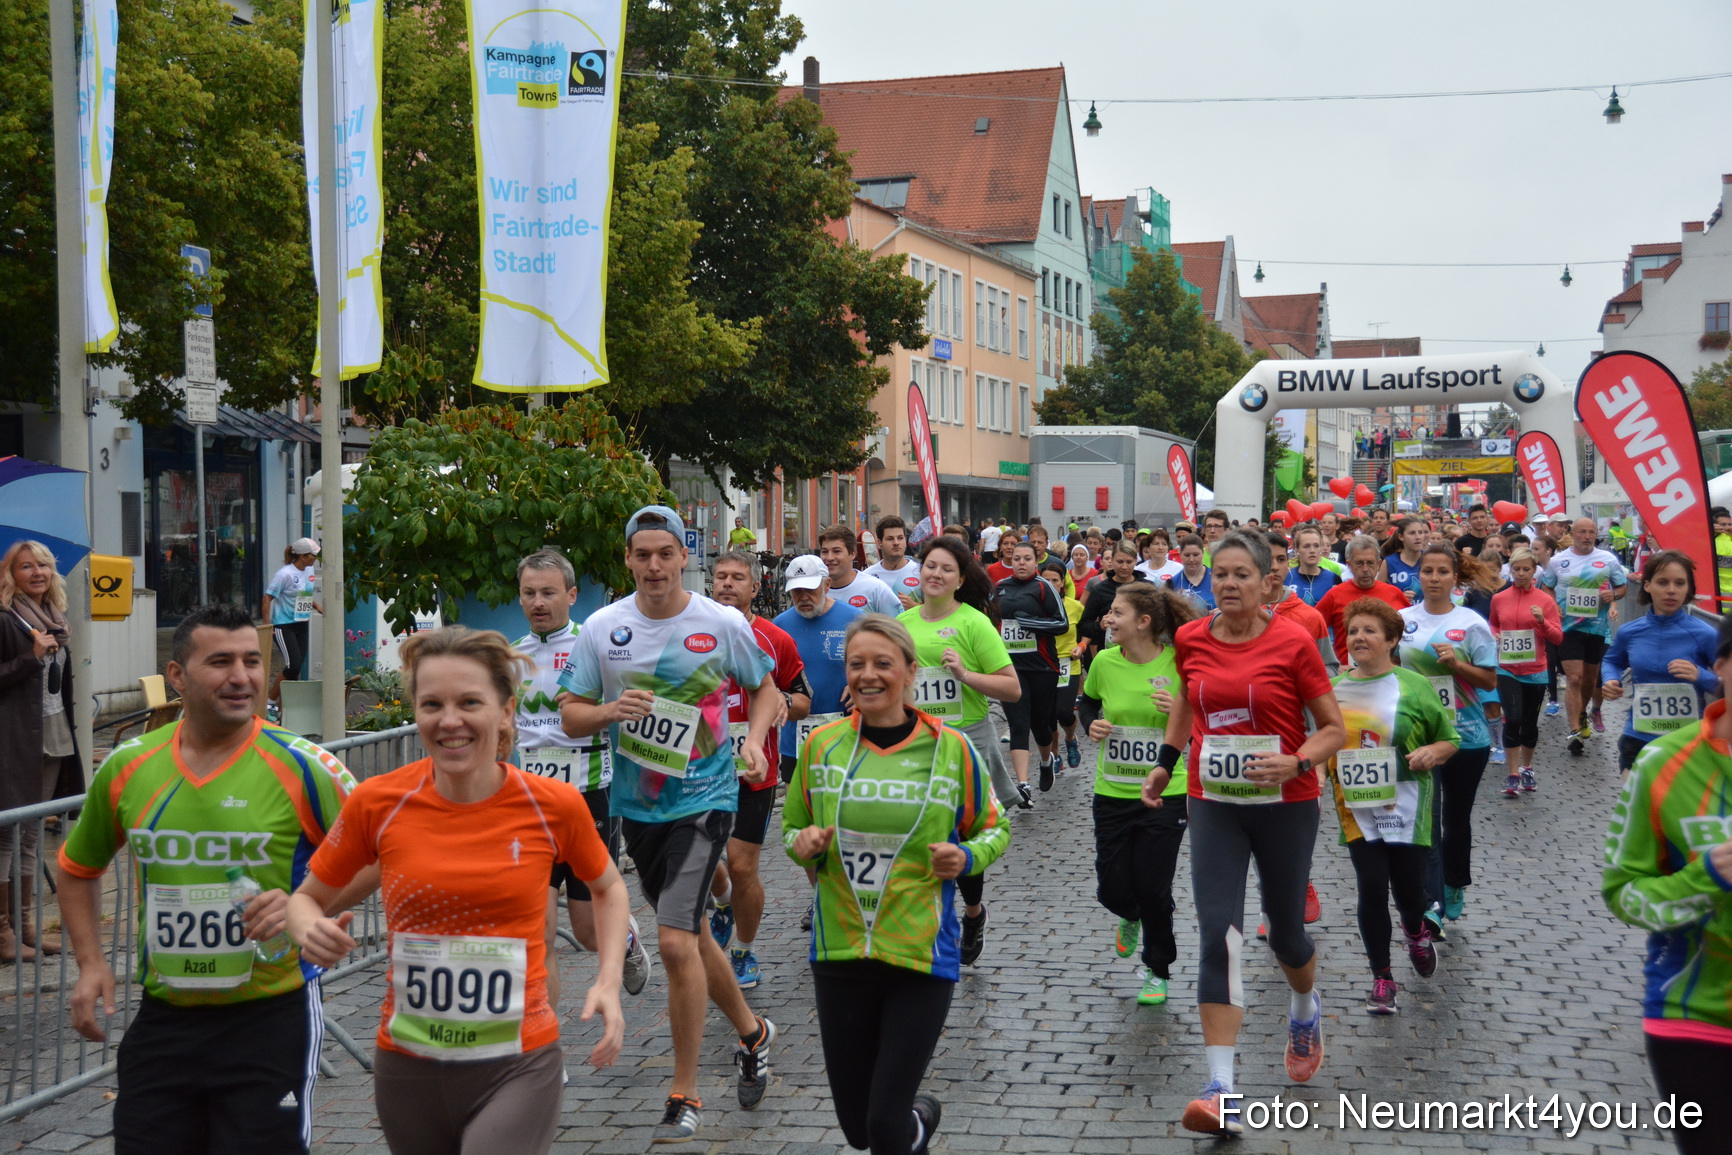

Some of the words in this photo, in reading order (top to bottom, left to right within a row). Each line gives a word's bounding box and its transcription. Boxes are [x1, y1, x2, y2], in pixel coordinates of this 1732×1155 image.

[486, 48, 556, 67] Kampagne
[487, 62, 563, 82] Fairtrade
[519, 87, 557, 102] Towns
[570, 86, 604, 94] FAIRTRADE
[489, 177, 529, 203] Wir
[537, 178, 577, 204] sind
[493, 213, 599, 239] Fairtrade-
[493, 249, 556, 274] Stadt!
[1278, 369, 1355, 392] BMW
[1362, 364, 1502, 392] Laufsport
[100, 447, 111, 471] 3
[1594, 376, 1696, 525] REWE
[1440, 461, 1468, 472] ZIEL
[1523, 440, 1561, 512] REWE
[1171, 454, 1195, 522] REWE
[687, 534, 695, 545] P
[1390, 571, 1408, 583] 10
[1569, 594, 1597, 607] 5186
[688, 637, 714, 649] Hervis
[1004, 627, 1033, 641] 5152
[1503, 637, 1532, 651] 5135
[656, 700, 693, 716] BOCK
[1640, 696, 1692, 716] 5183
[1219, 713, 1238, 721] DEHN
[1652, 721, 1680, 730] Sophia
[626, 713, 690, 748] 5097
[631, 741, 669, 763] Michael
[1109, 738, 1157, 762] 5068
[1116, 765, 1146, 776] Tamara
[1208, 753, 1258, 780] 508
[1342, 762, 1390, 785] 5251
[1221, 785, 1260, 796] Martina
[1352, 791, 1382, 800] Christa
[129, 829, 273, 865] BOCK
[859, 896, 878, 908] nie
[157, 911, 247, 949] 5266
[449, 941, 514, 957] BOCK
[184, 959, 217, 973] Azad
[406, 964, 513, 1015] 5090
[429, 1023, 477, 1043] Maria
